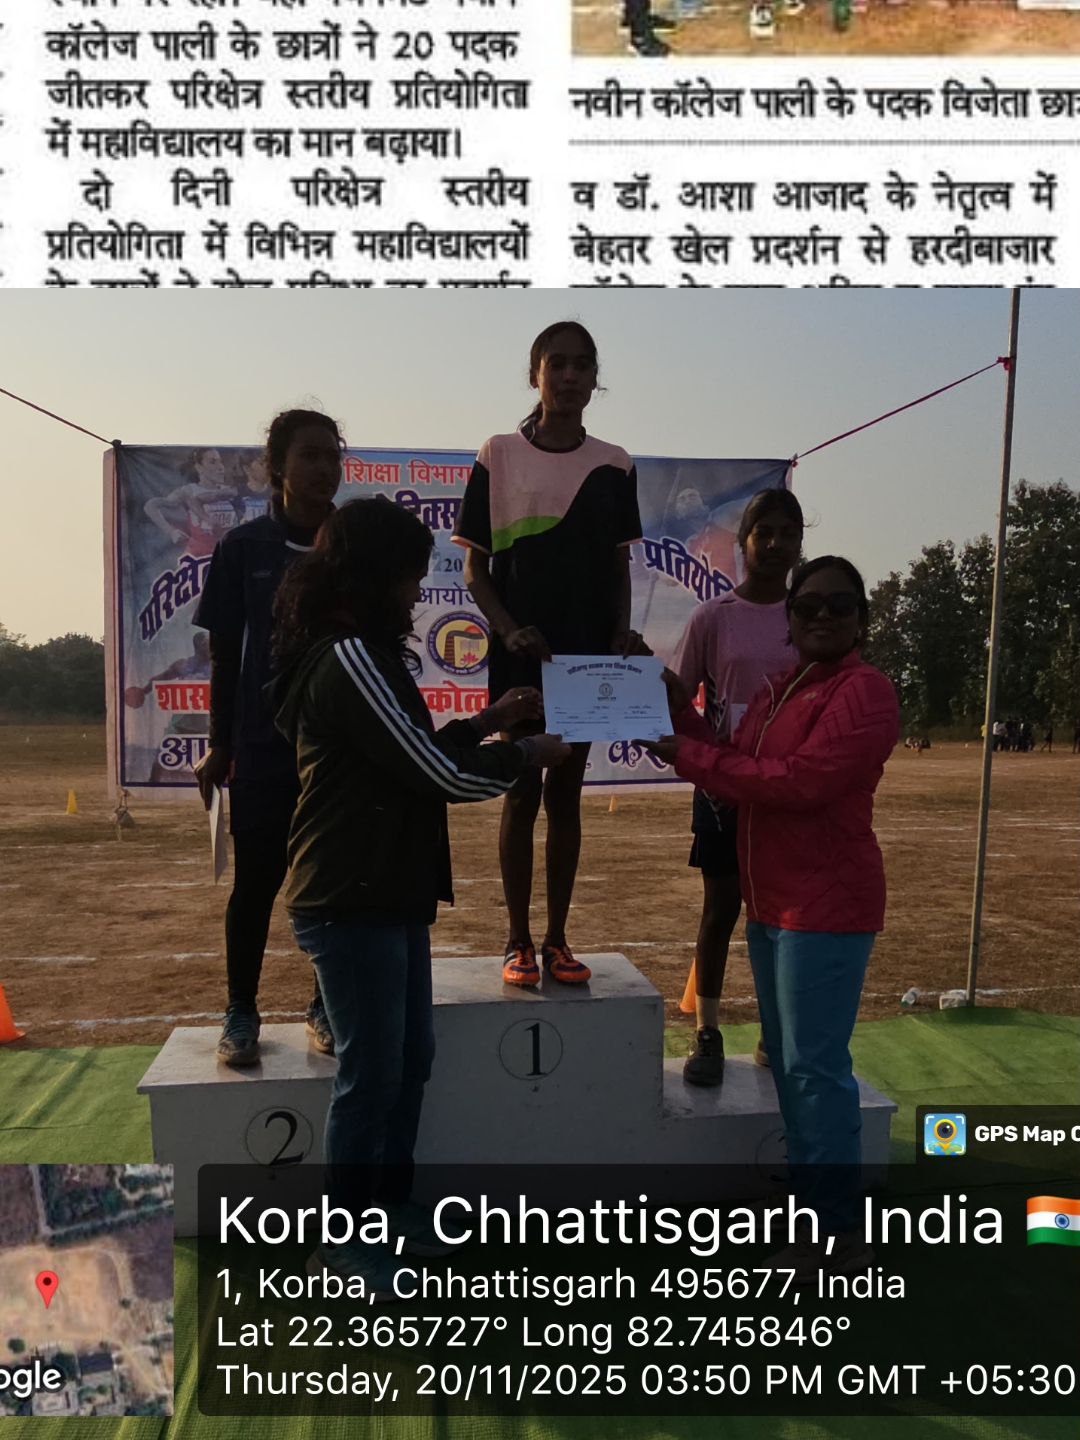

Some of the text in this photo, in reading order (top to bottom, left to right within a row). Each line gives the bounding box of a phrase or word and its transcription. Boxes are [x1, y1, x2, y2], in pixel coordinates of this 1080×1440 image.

[569, 79, 645, 117] नवीन
[650, 77, 744, 118] कॉलेज
[751, 79, 818, 118] पाली
[823, 77, 857, 117] के
[864, 89, 934, 119] पदक
[941, 77, 1031, 117] विजेता
[571, 171, 1057, 220] व डॉ. आशा आजाद के नेतृत्व में
[343, 457, 399, 483] शिक्षा
[524, 1022, 548, 1076] 1
[265, 1111, 304, 1165] 2
